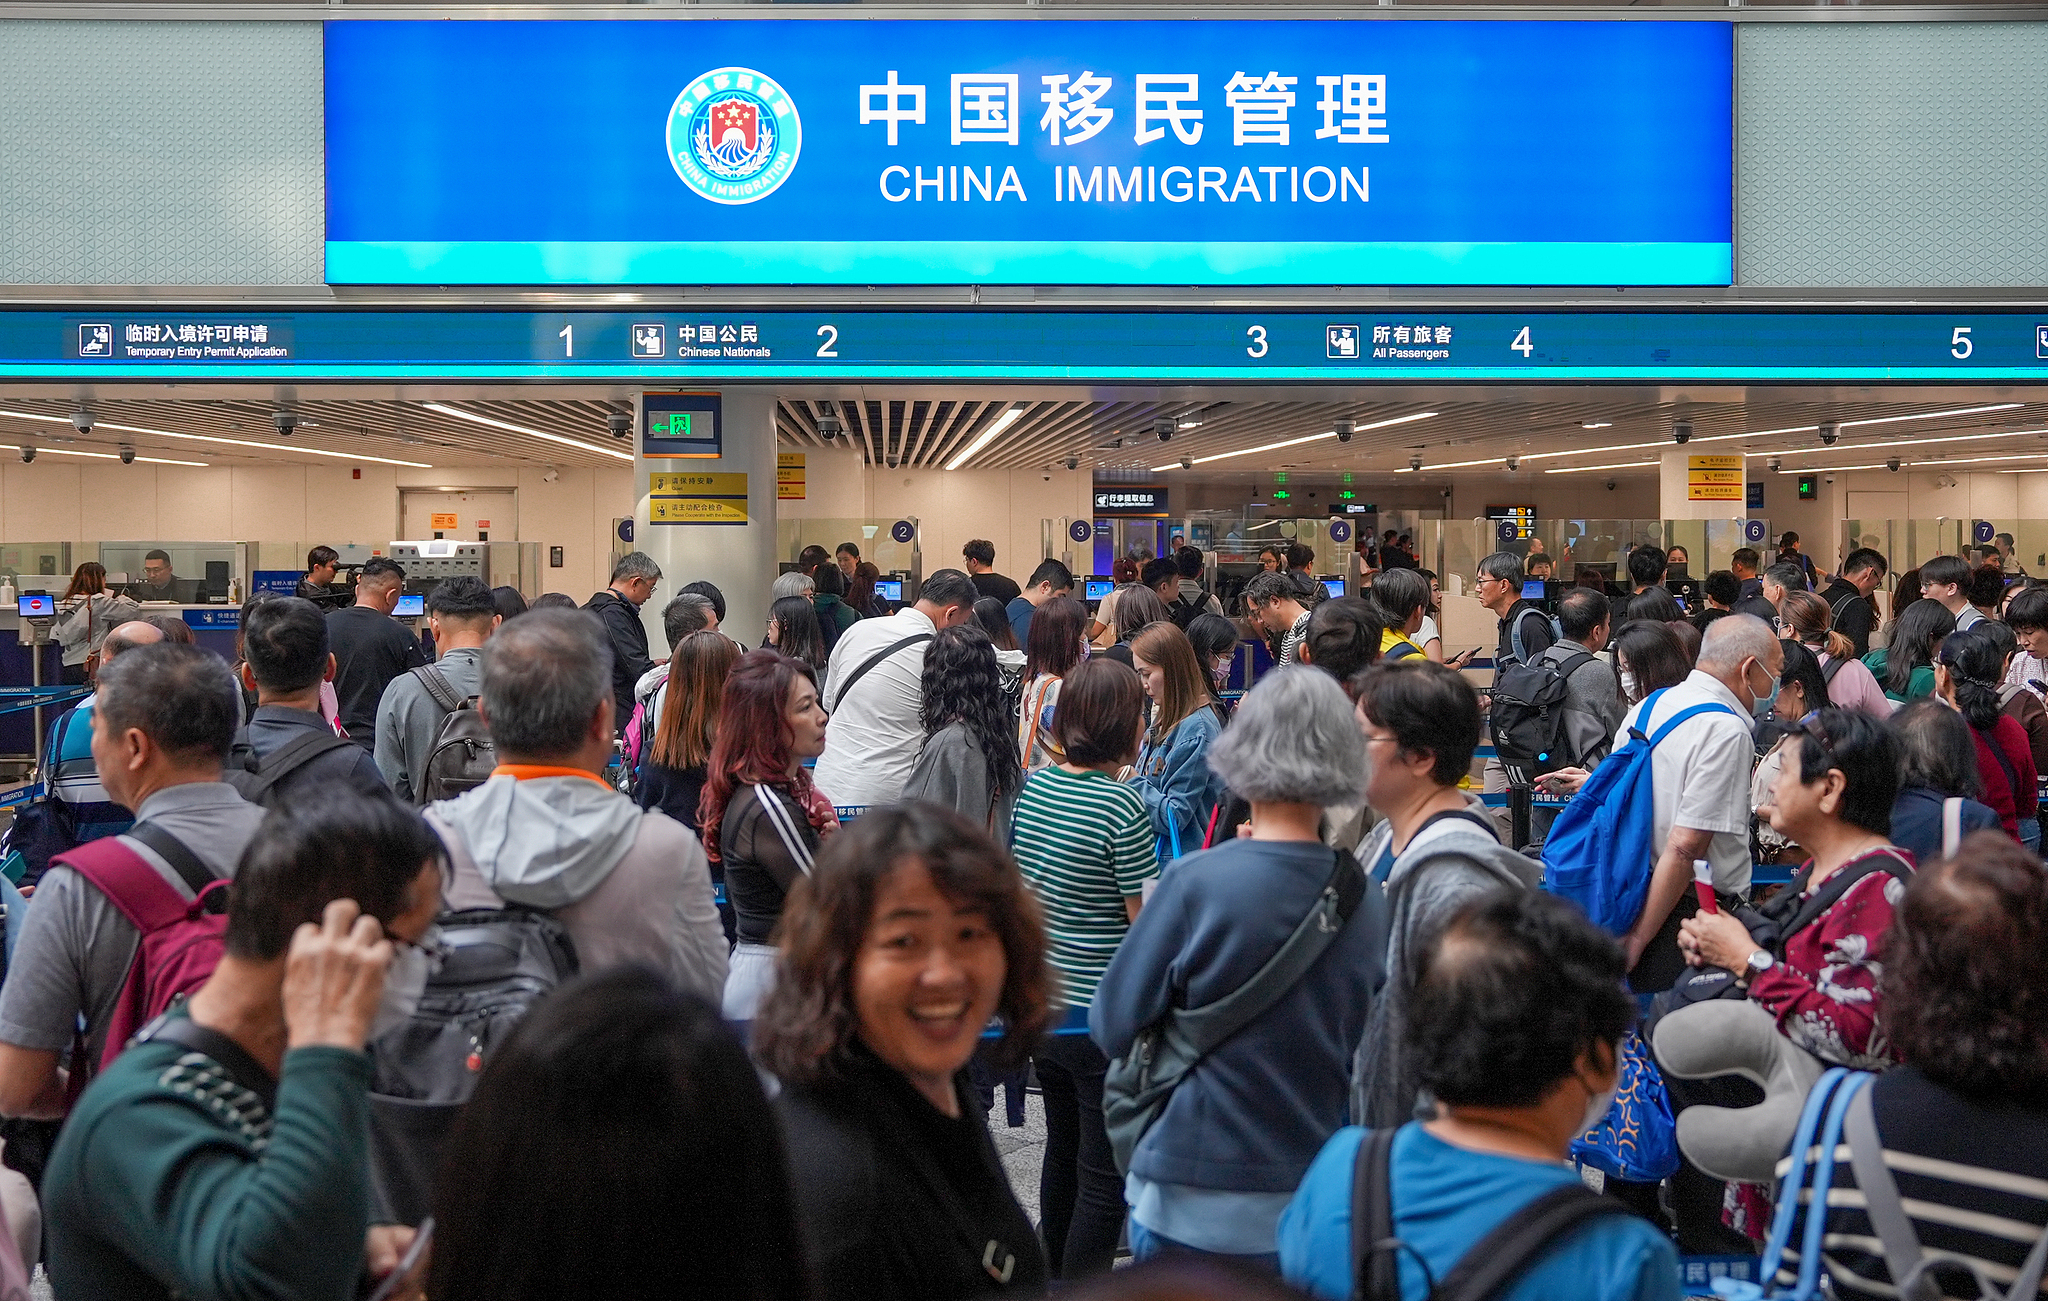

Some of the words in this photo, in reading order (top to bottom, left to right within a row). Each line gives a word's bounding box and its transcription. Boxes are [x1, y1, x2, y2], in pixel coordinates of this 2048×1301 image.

[859, 70, 1390, 146] 中国移民管理
[677, 151, 708, 188] CHINA
[711, 151, 791, 197] IMMIGRATION
[879, 165, 1028, 202] CHINA
[1055, 165, 1369, 202] IMMIGRATION
[125, 324, 268, 343] 临时入境许可申请
[679, 324, 758, 343] 中国公民
[1372, 325, 1452, 344] 所有旅客
[559, 324, 573, 357] 1
[816, 325, 839, 357] 2
[1246, 325, 1269, 358] 3
[1510, 326, 1534, 357] 4
[1951, 327, 1973, 359] 5
[125, 346, 175, 358] Temporary
[177, 346, 201, 358] Entry
[204, 346, 235, 357] Permit
[236, 346, 287, 358] Application
[678, 346, 721, 357] Chinese
[723, 346, 771, 357] Nationals
[1372, 348, 1387, 358] All
[1389, 348, 1449, 360] Passengers
[672, 477, 714, 485] 请保持安静
[1109, 494, 1154, 502] 行李提取信息
[672, 503, 723, 511] 请主动配合检查
[626, 526, 632, 537] 1
[899, 526, 907, 537] 2
[1077, 525, 1085, 537] 3
[1336, 526, 1345, 537] 4
[1505, 527, 1513, 538] 5
[1751, 525, 1760, 537] 6
[1981, 526, 1989, 537] 7
